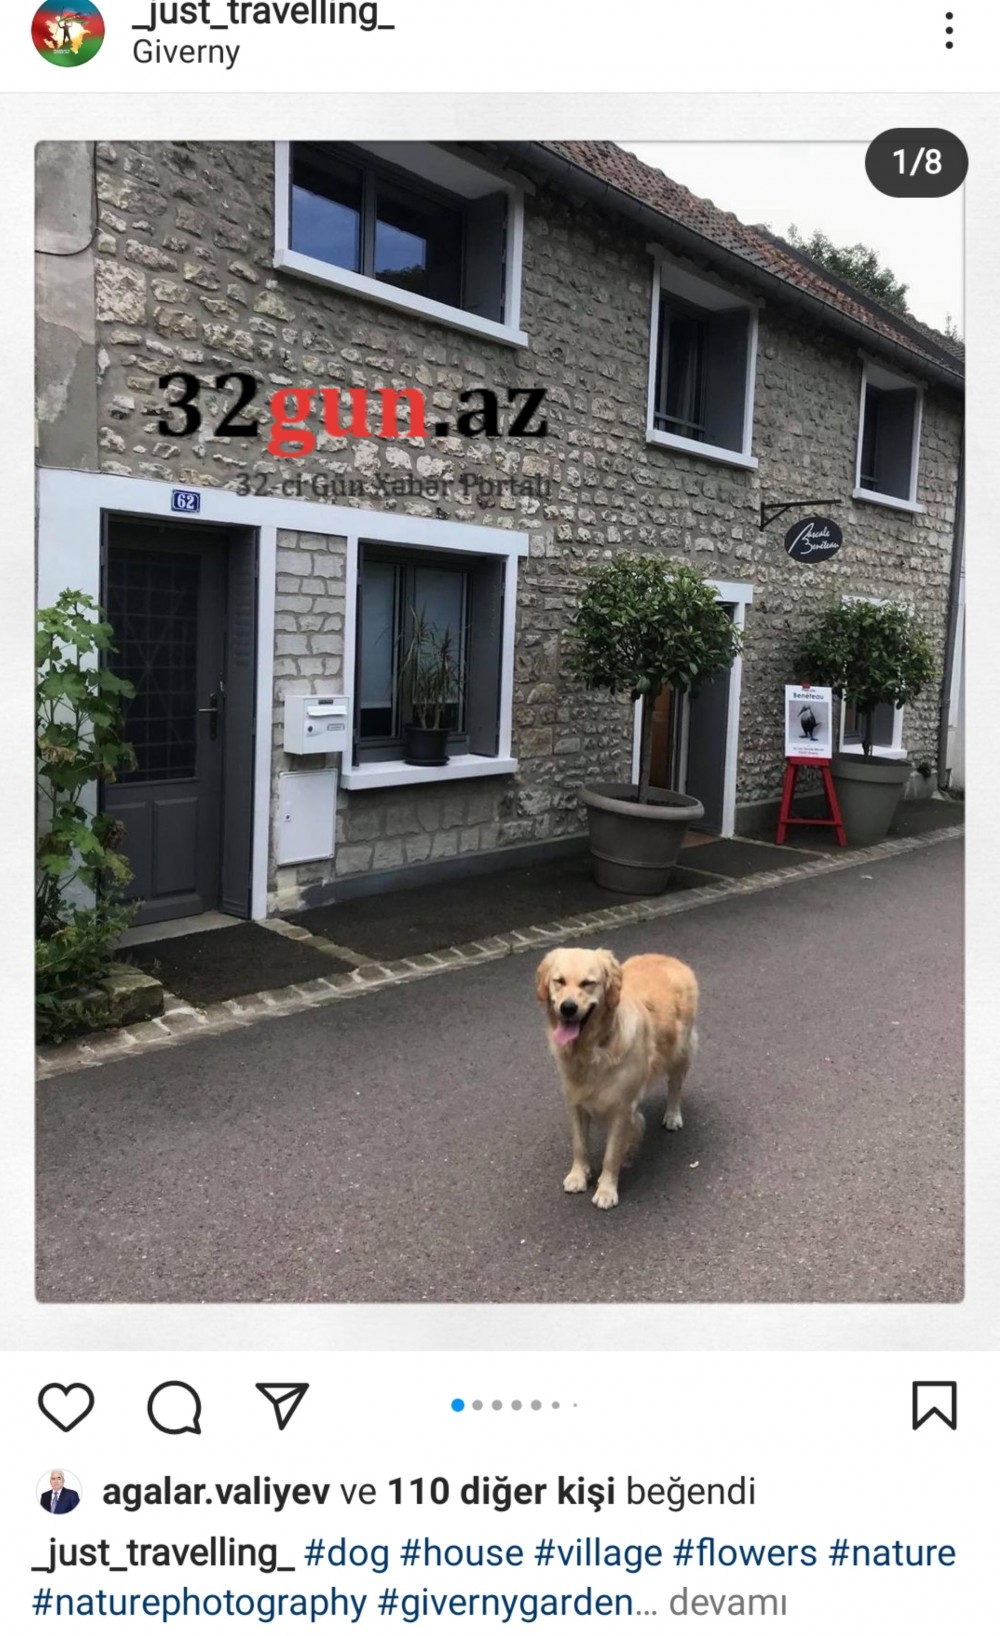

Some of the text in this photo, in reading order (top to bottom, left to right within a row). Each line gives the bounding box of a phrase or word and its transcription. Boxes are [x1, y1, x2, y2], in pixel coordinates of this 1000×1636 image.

[131, 0, 396, 32] _just_travelling_
[132, 39, 241, 70] Giverny
[893, 147, 942, 176] 1/8
[177, 493, 195, 510] 62
[103, 1475, 755, 1514] agalar.valiyev ve 110 diğer kişi beğendi
[31, 1535, 957, 1574] _just_travelling_ #dog #house #village #flowers #nature
[31, 1586, 368, 1624] #naturephotography
[669, 1586, 787, 1616] devamı
